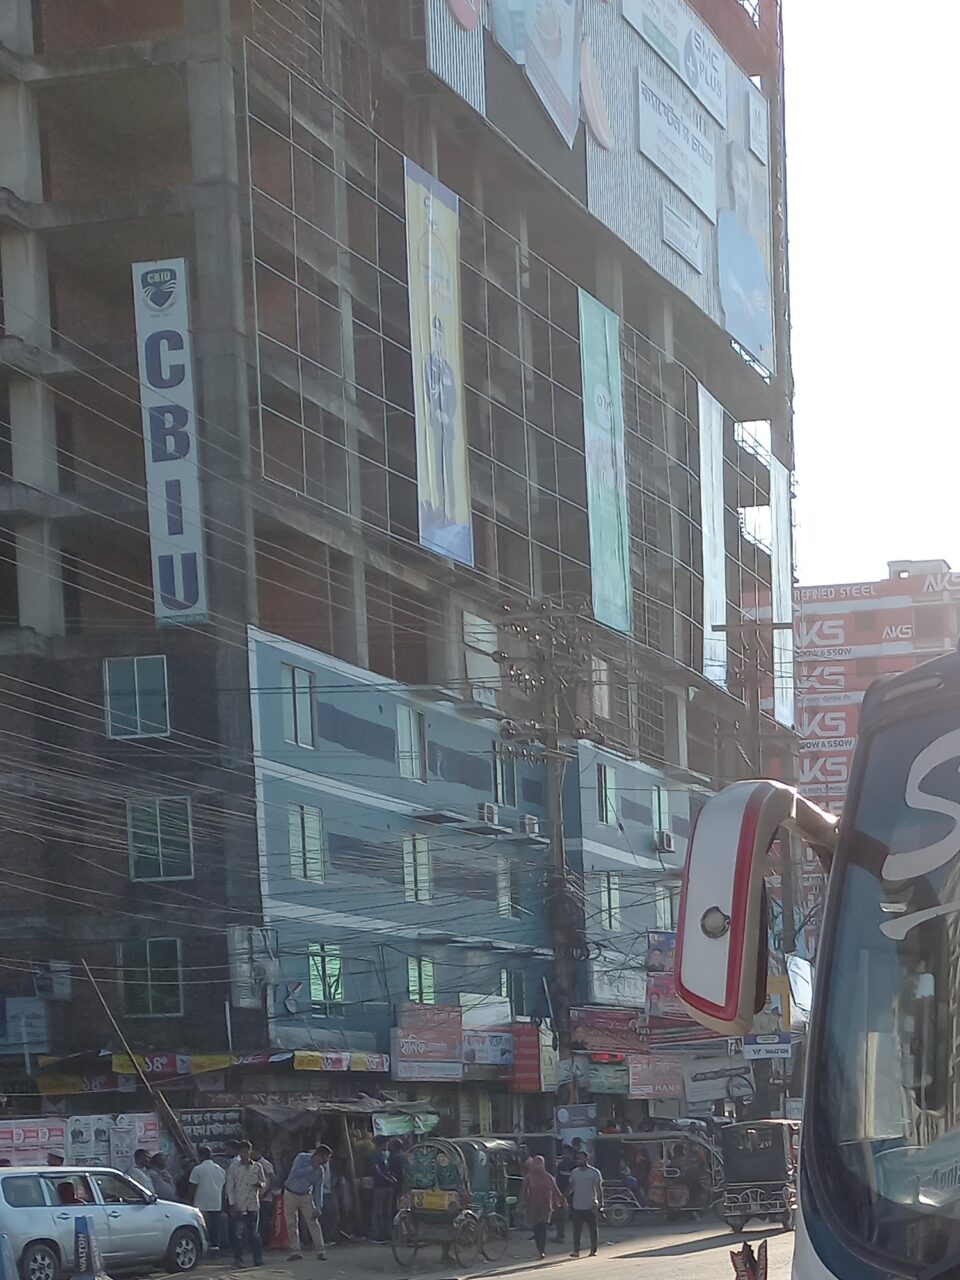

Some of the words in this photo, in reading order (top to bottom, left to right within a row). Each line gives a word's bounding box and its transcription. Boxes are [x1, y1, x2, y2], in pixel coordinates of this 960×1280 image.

[694, 30, 720, 73] SMC
[699, 63, 722, 99] PLUS
[144, 329, 200, 611] CBIU
[794, 587, 835, 600] REFINED
[840, 585, 877, 597] STEEL
[882, 625, 913, 639] AKS
[801, 711, 846, 737] KS
[78, 1234, 87, 1272] WALTON
